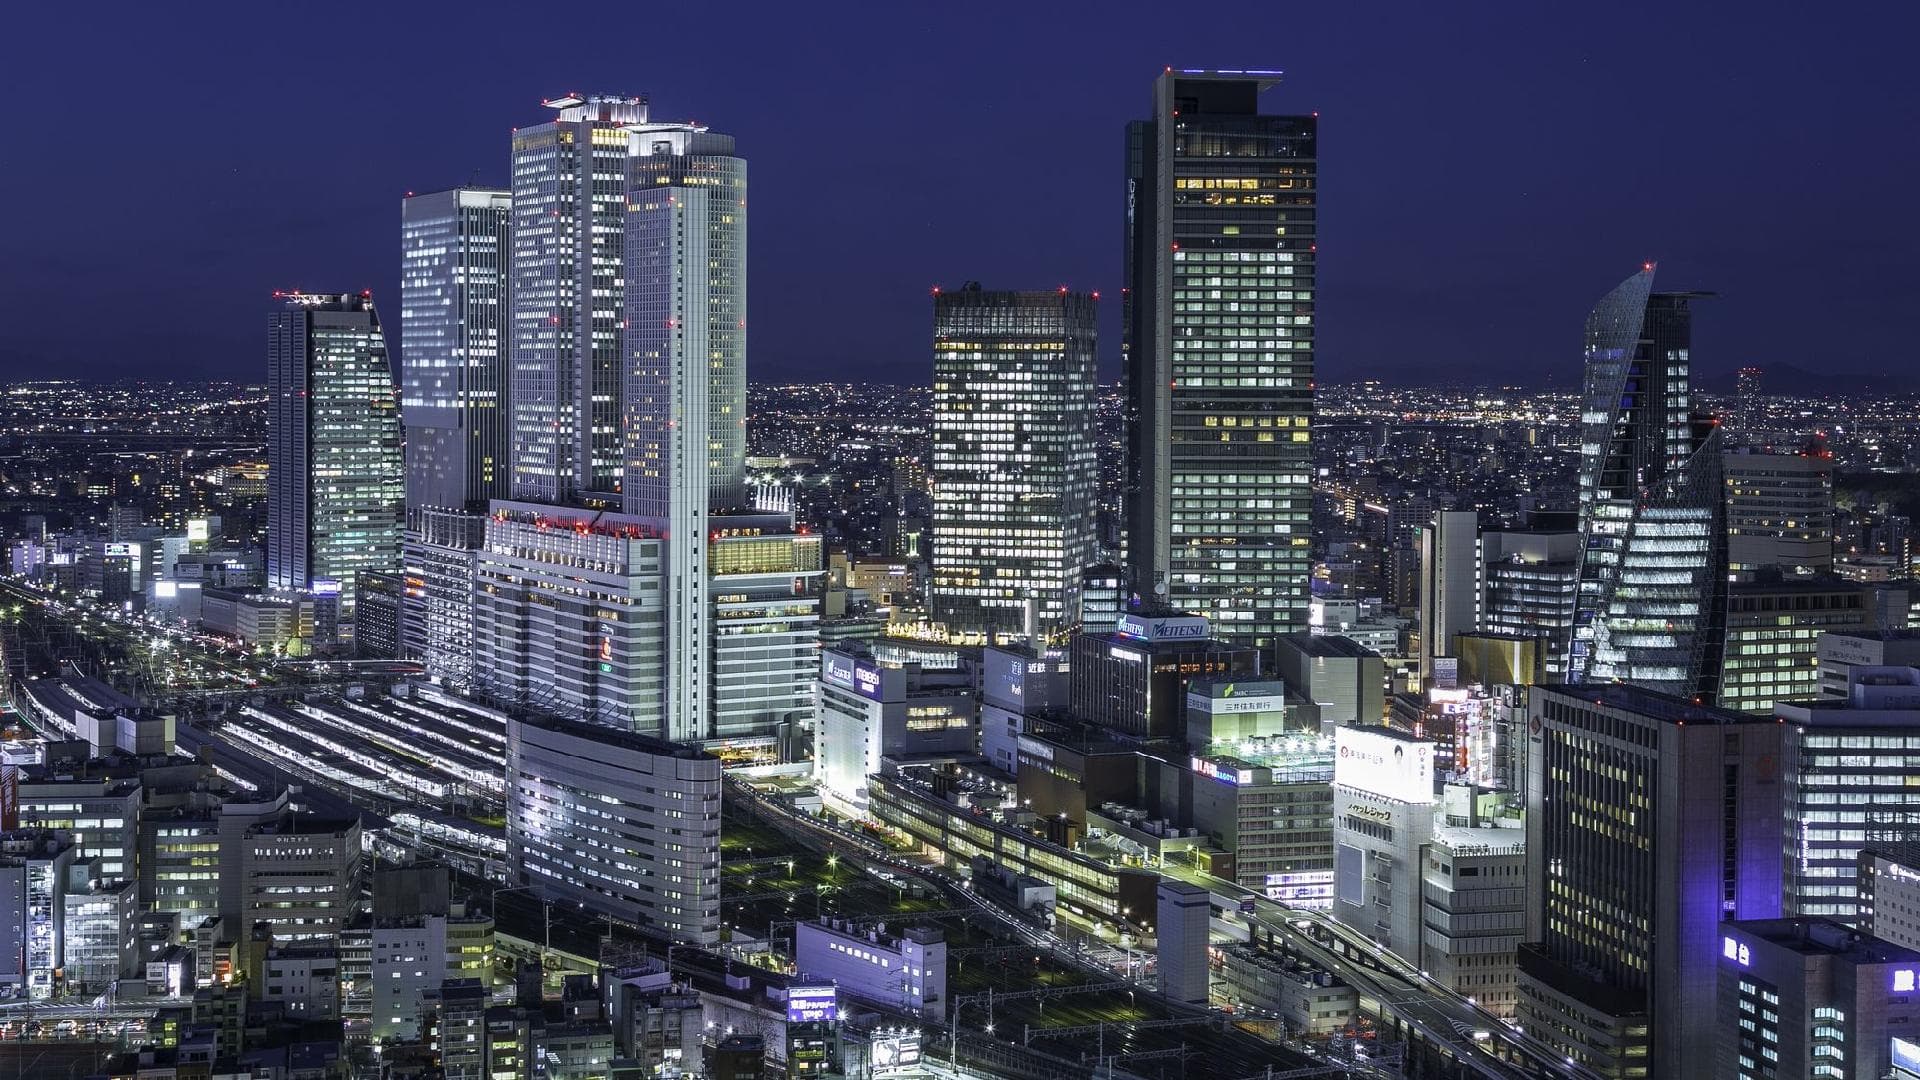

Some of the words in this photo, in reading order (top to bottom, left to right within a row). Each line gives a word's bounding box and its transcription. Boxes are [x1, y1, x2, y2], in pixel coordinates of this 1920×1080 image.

[1152, 619, 1204, 637] MEITETSU
[1028, 663, 1046, 673] 近鉄
[1225, 701, 1271, 711] 三井住友銀行
